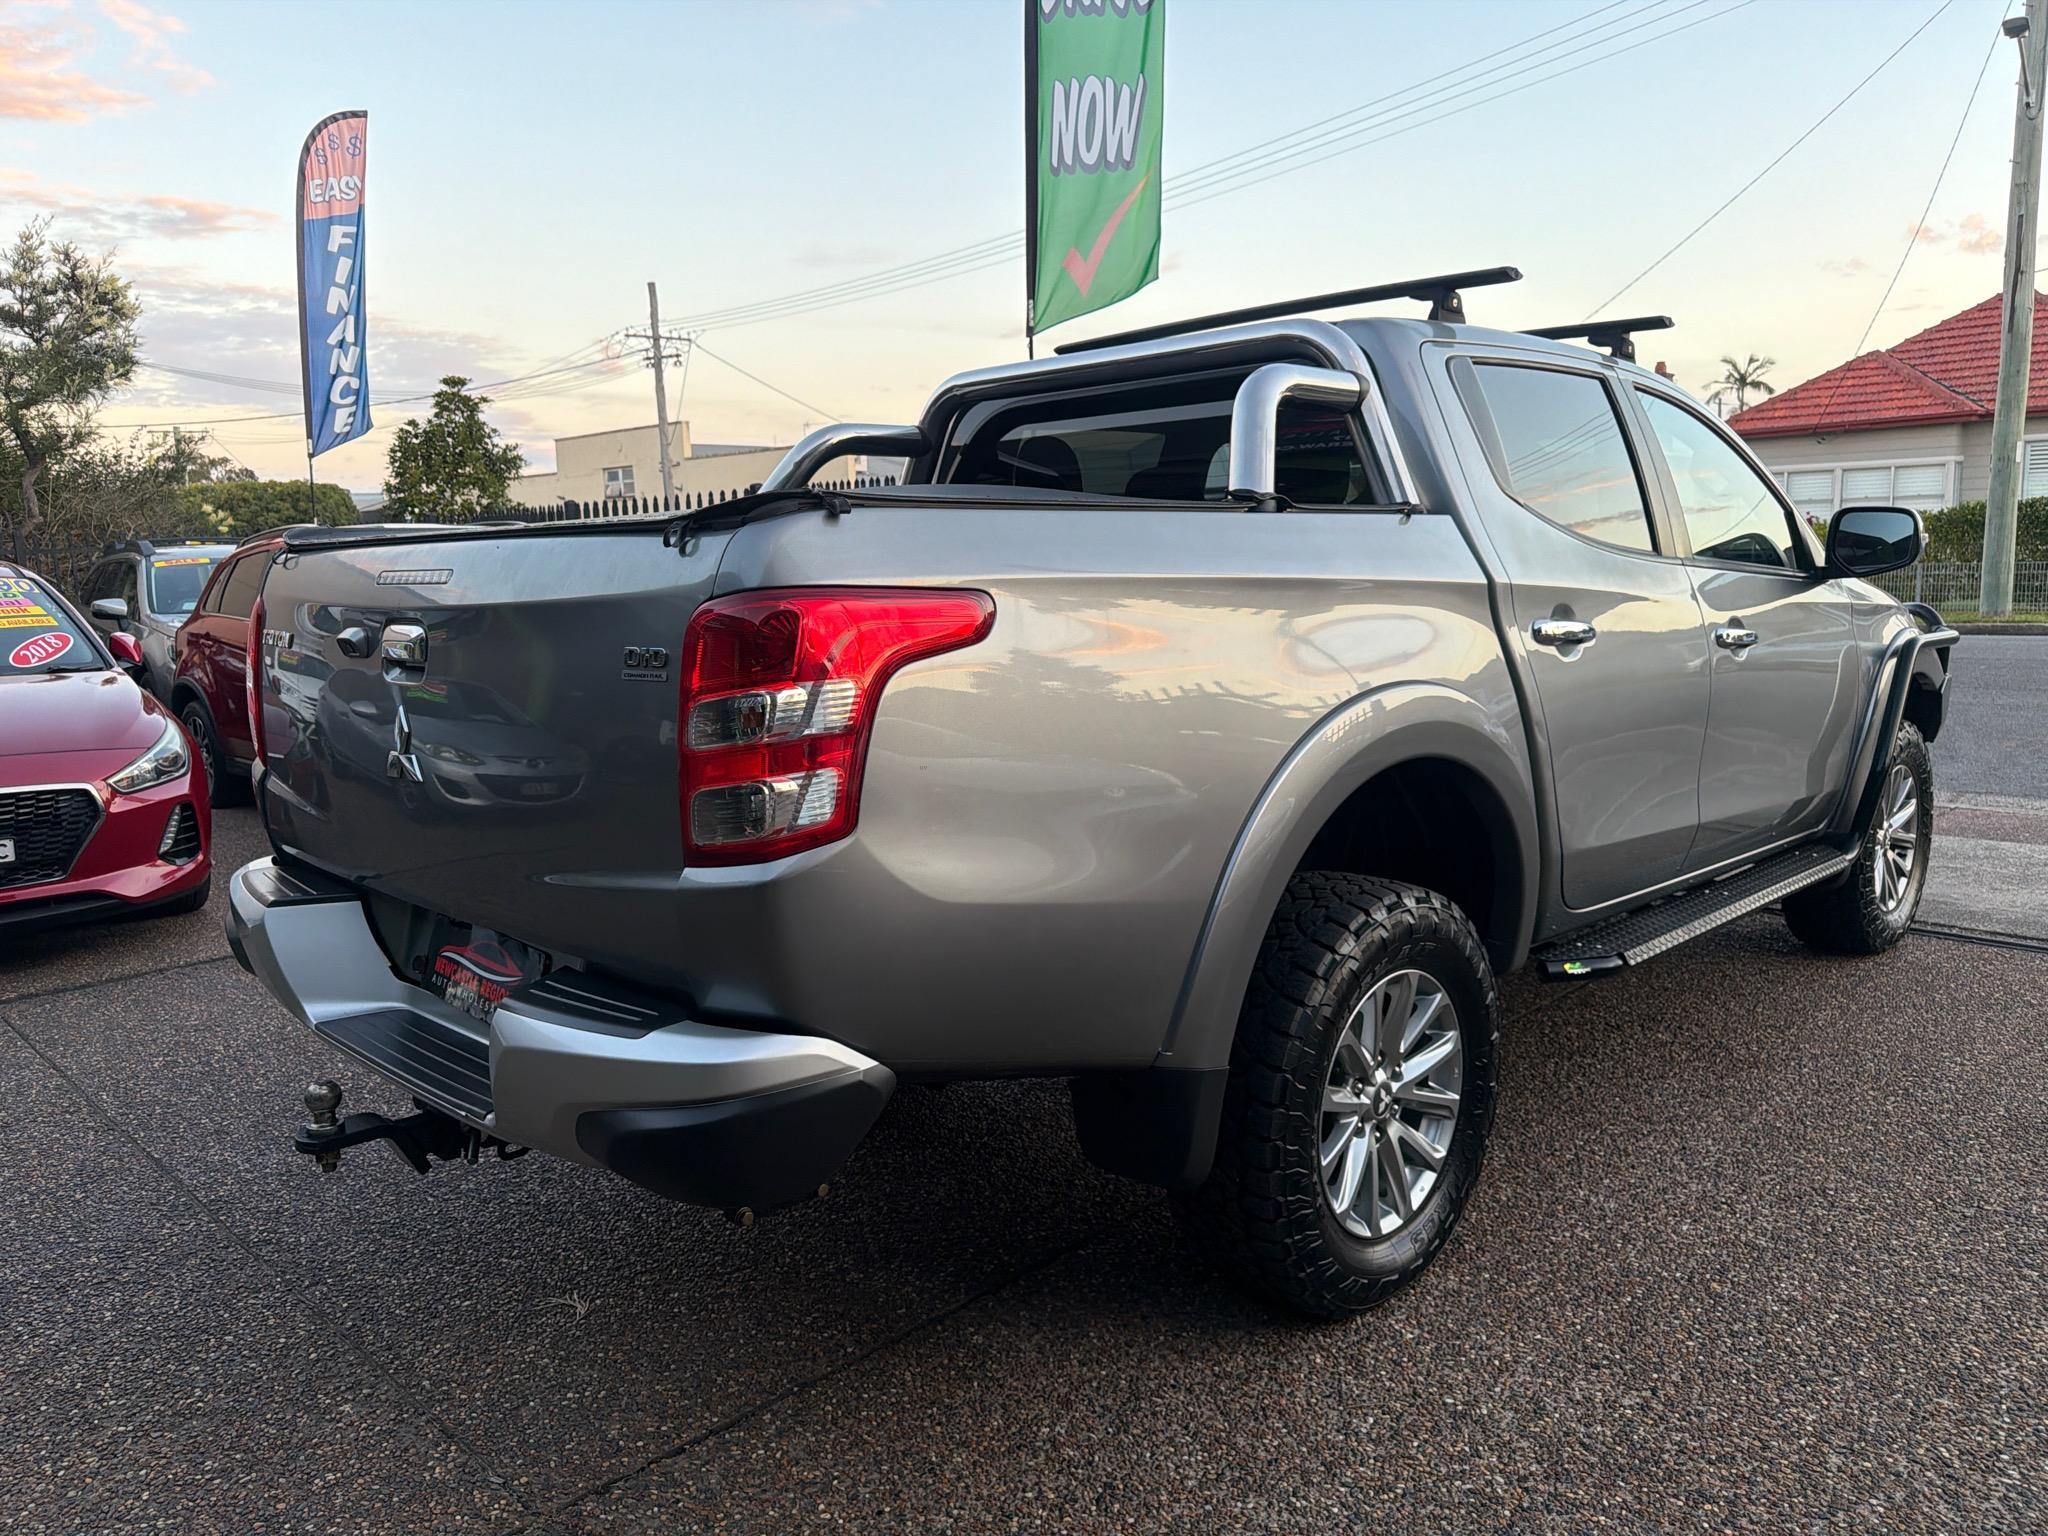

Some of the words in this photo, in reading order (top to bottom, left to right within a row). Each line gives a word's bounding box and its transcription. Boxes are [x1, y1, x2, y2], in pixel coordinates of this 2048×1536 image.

[1051, 73, 1145, 174] NOW
[326, 224, 360, 433] FINANCE
[20, 635, 62, 664] 2018
[432, 974, 452, 991] AUTO
[435, 956, 478, 991] NEWCASTLE
